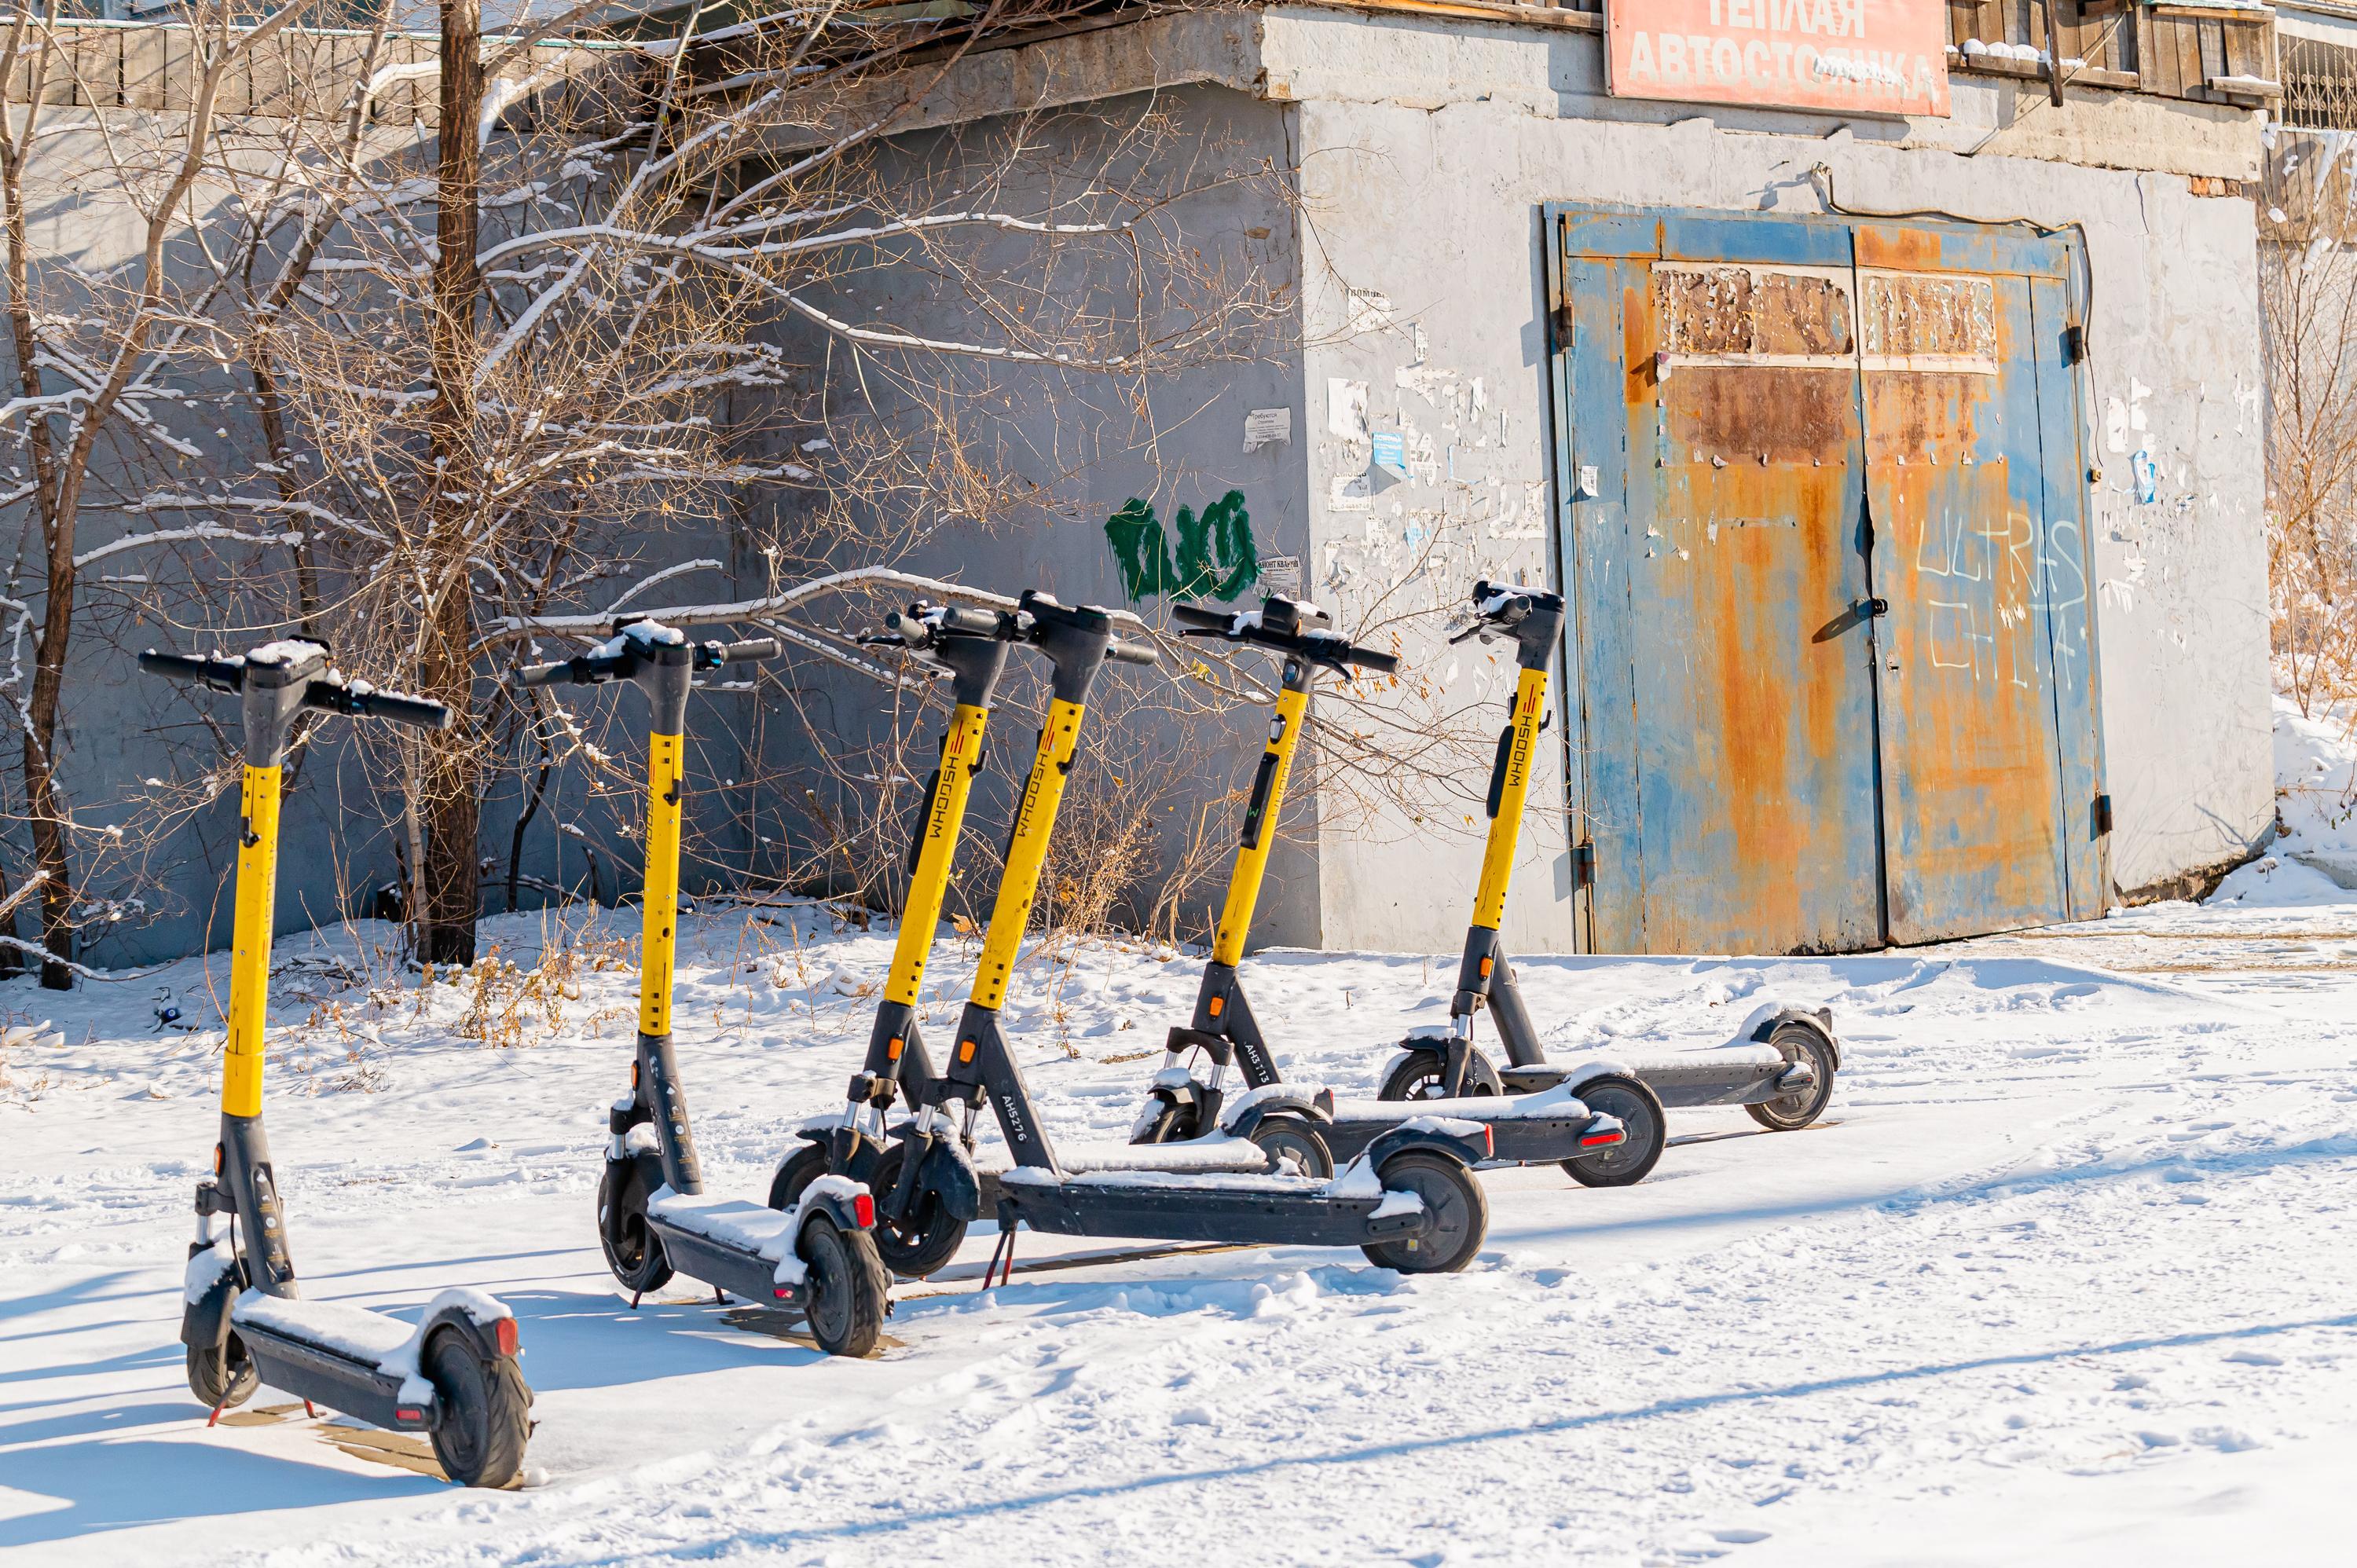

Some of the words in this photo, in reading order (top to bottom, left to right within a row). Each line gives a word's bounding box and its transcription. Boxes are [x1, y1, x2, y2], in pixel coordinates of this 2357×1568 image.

[1508, 715, 1533, 786] WHOOSH
[929, 756, 959, 838] WHOOSH
[1017, 753, 1048, 837] WHOOSH
[1002, 1096, 1027, 1141] AH5276
